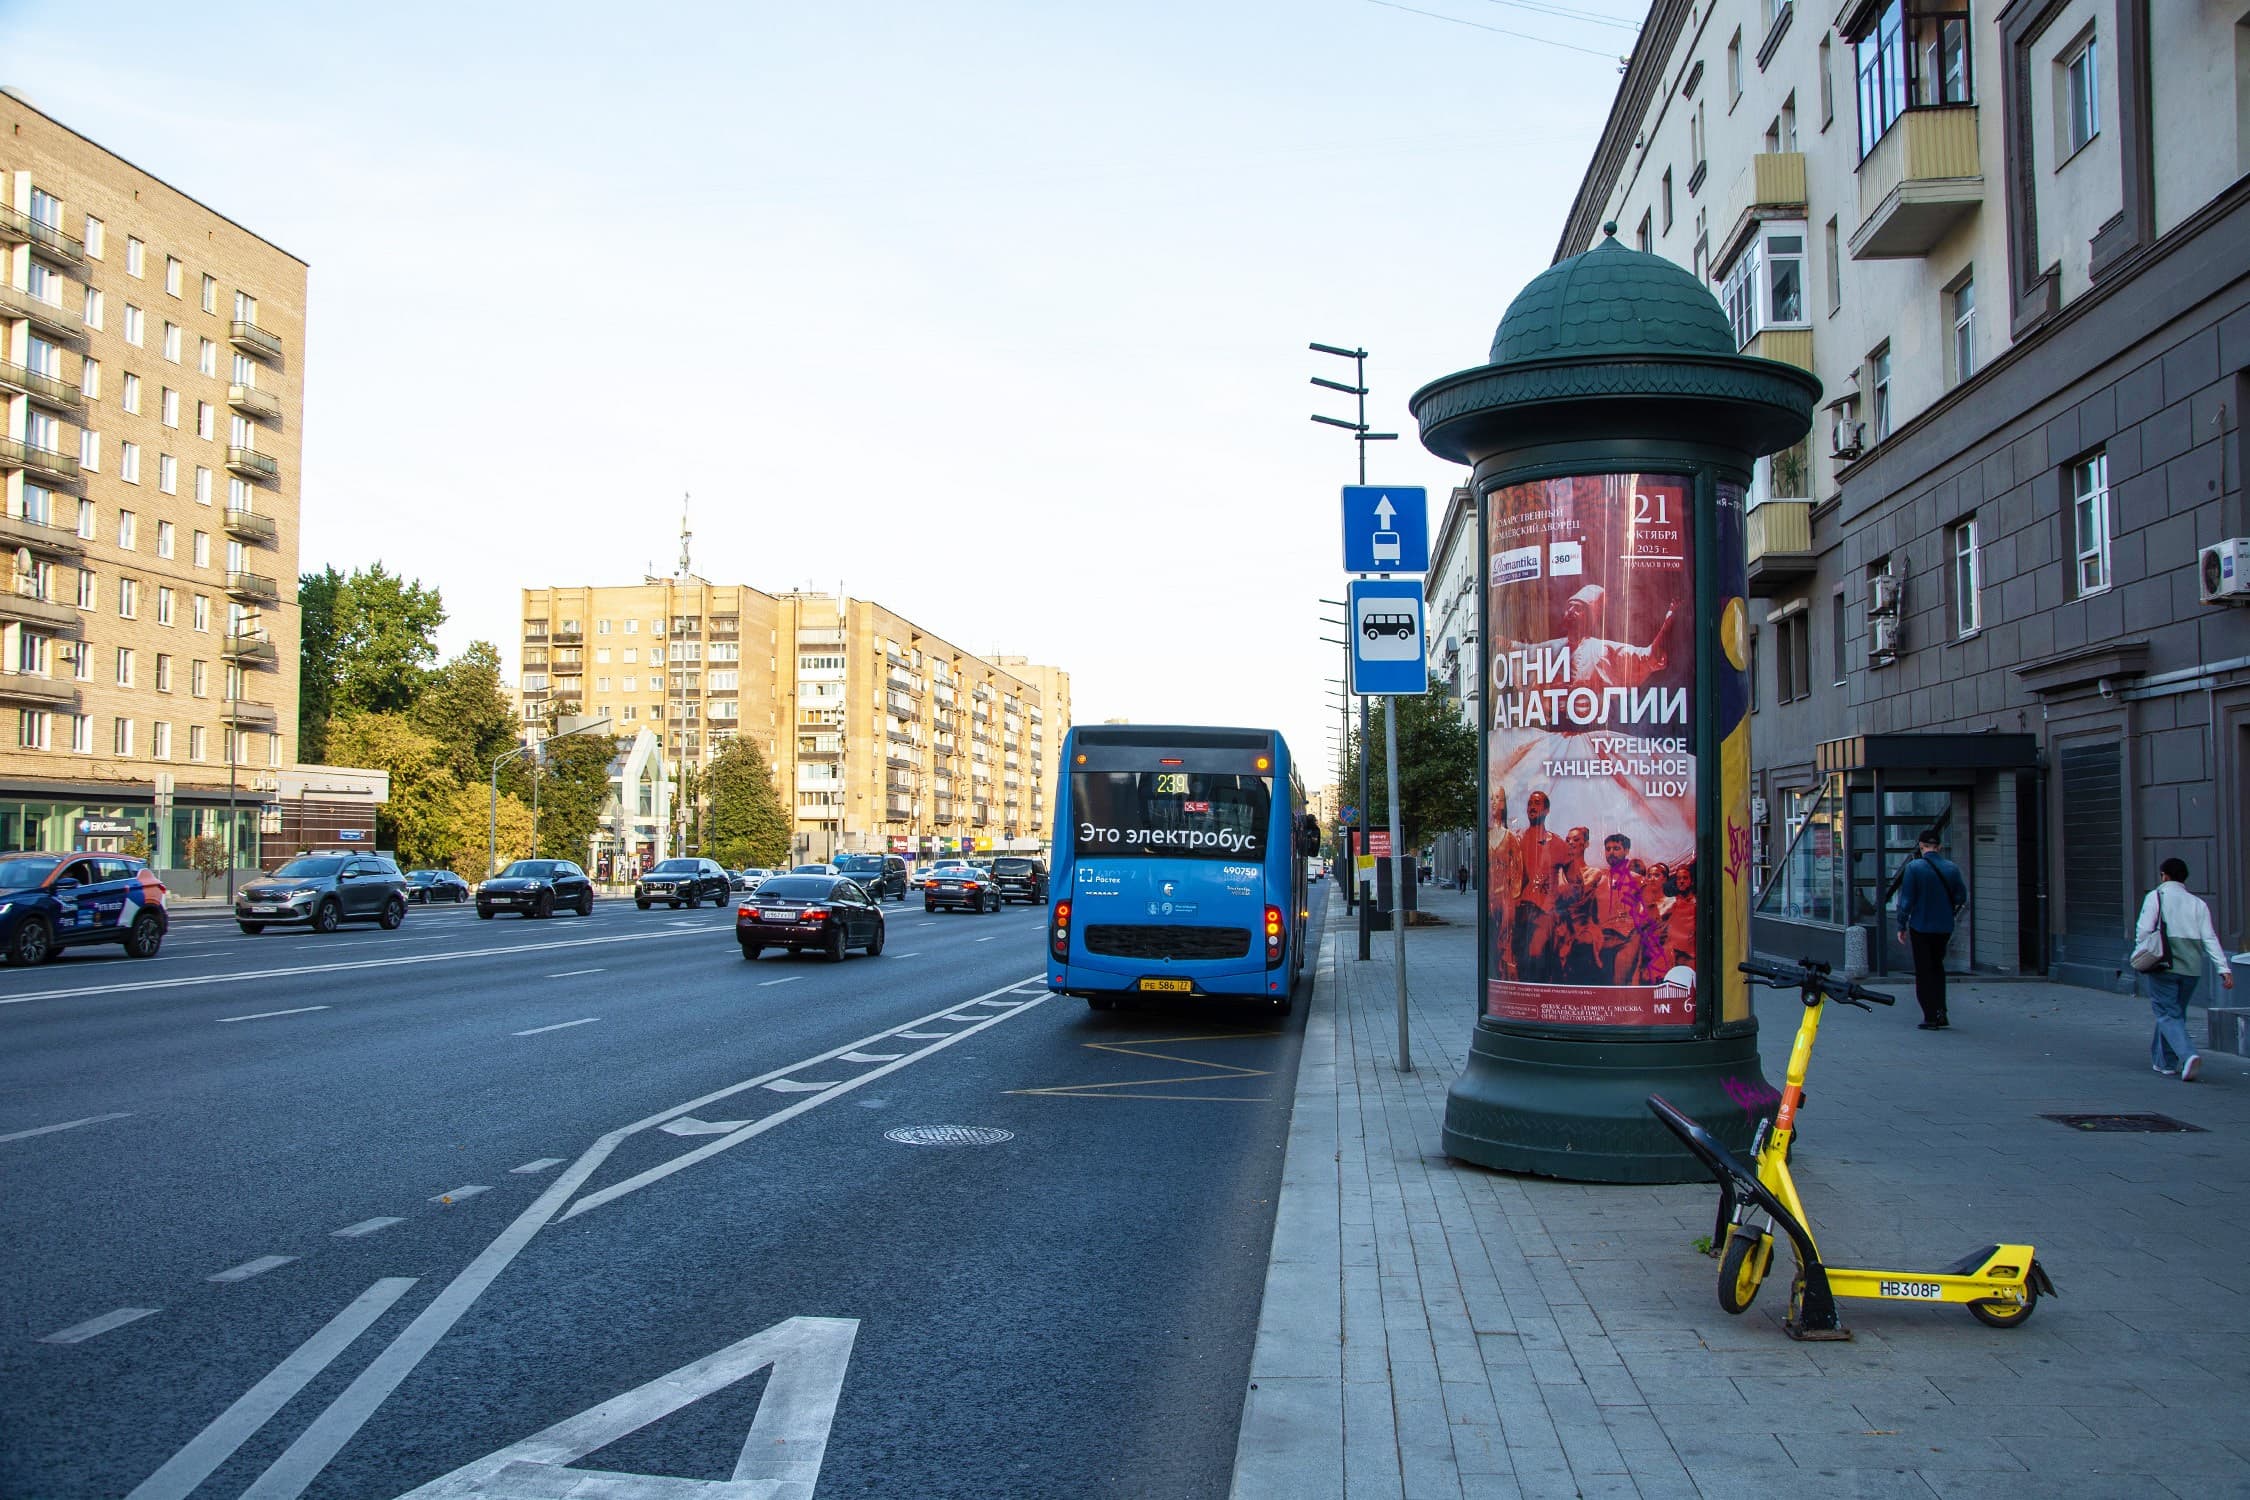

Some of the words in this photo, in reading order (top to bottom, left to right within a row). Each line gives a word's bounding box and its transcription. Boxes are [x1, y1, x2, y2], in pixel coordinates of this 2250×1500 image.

[1633, 494, 1671, 524] 21
[1637, 545, 1660, 553] 2025
[1492, 646, 1570, 690] ОГНИ
[1493, 687, 1687, 730] АНАТОЛИИ
[1591, 738, 1687, 756] ТУРЕЦКОЕ
[1543, 760, 1687, 778] ТАНЦЕВАЛЬНОЕ
[1157, 774, 1186, 793] 239
[1646, 781, 1688, 797] ШОУ
[1080, 822, 1120, 843] Это
[1125, 827, 1257, 853] электробус
[1095, 876, 1121, 884] Ростех
[1223, 866, 1257, 877] 490750
[1159, 980, 1175, 990] 586
